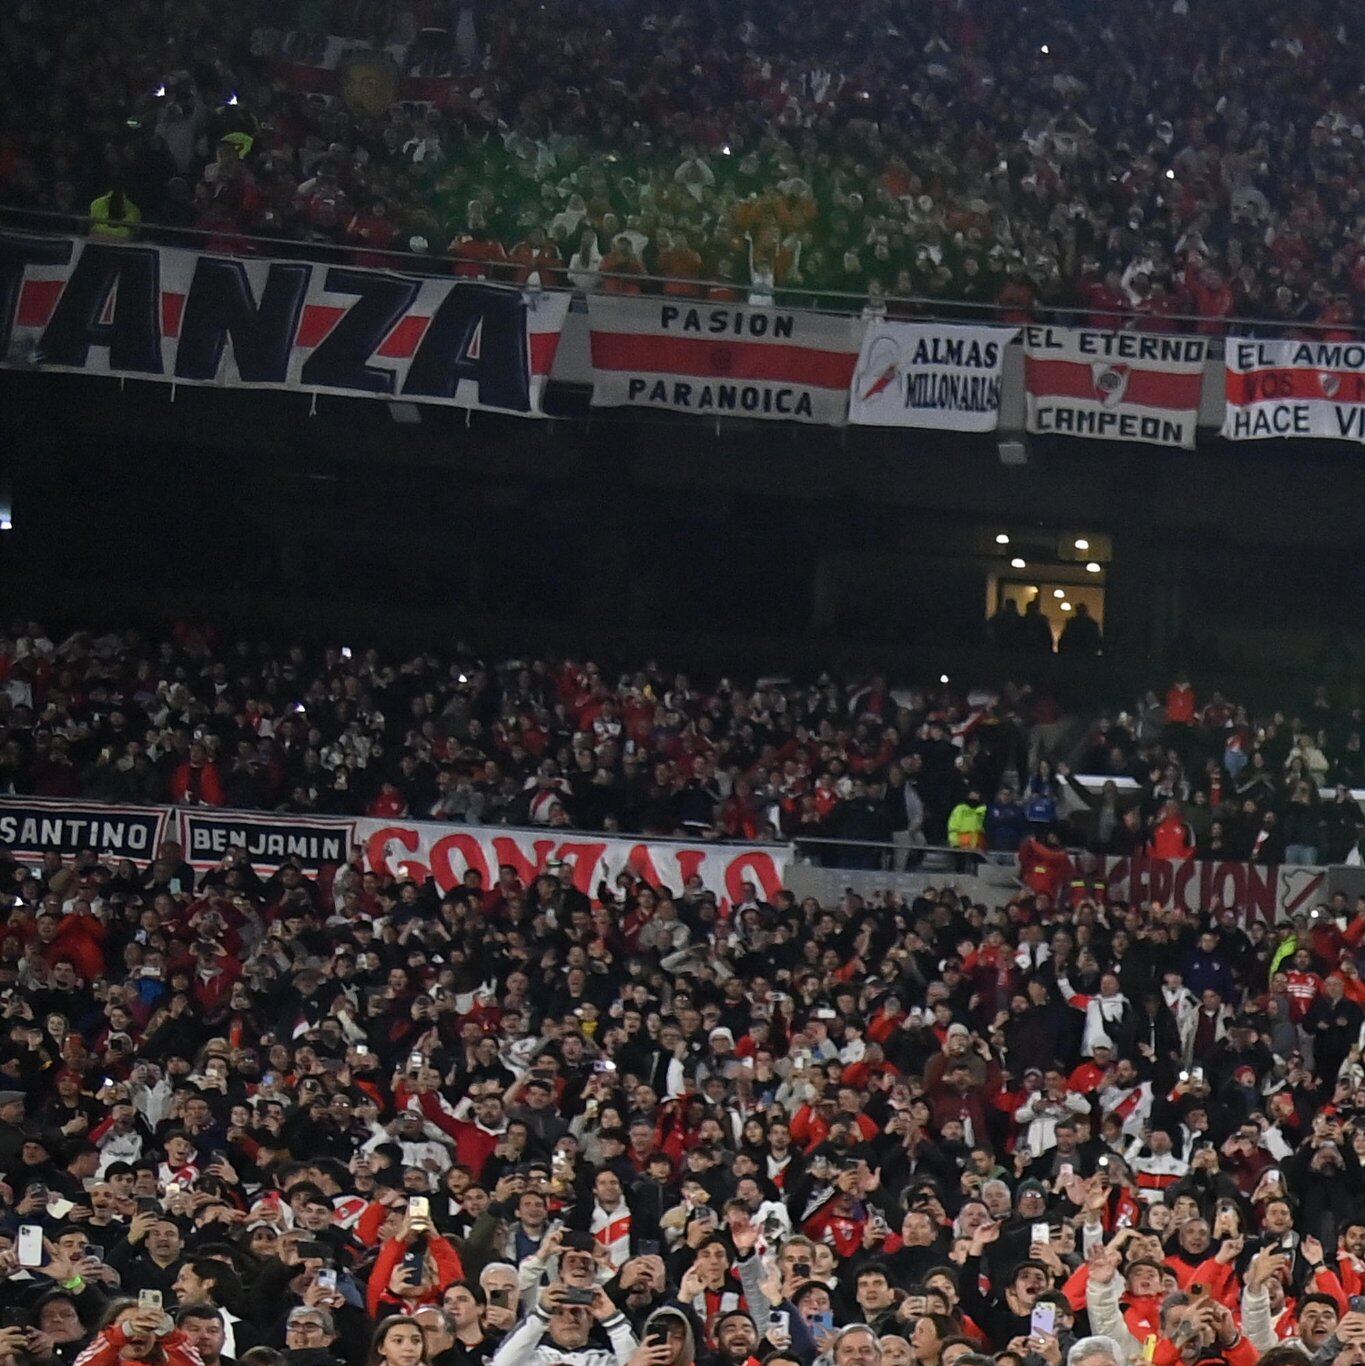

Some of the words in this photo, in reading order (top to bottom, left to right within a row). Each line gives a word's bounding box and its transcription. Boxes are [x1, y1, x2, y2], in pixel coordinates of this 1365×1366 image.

[661, 305, 794, 338] PASION
[912, 338, 998, 369] ALMAS
[1028, 326, 1063, 349] EL
[1079, 331, 1205, 363] ETERNO
[1238, 343, 1276, 370] EL
[628, 378, 813, 418] PARANOICA
[1037, 408, 1183, 443] CAMPEON
[1234, 405, 1311, 438] HACE
[0, 816, 148, 850] SANTINO
[193, 828, 340, 860] BENJAMIN
